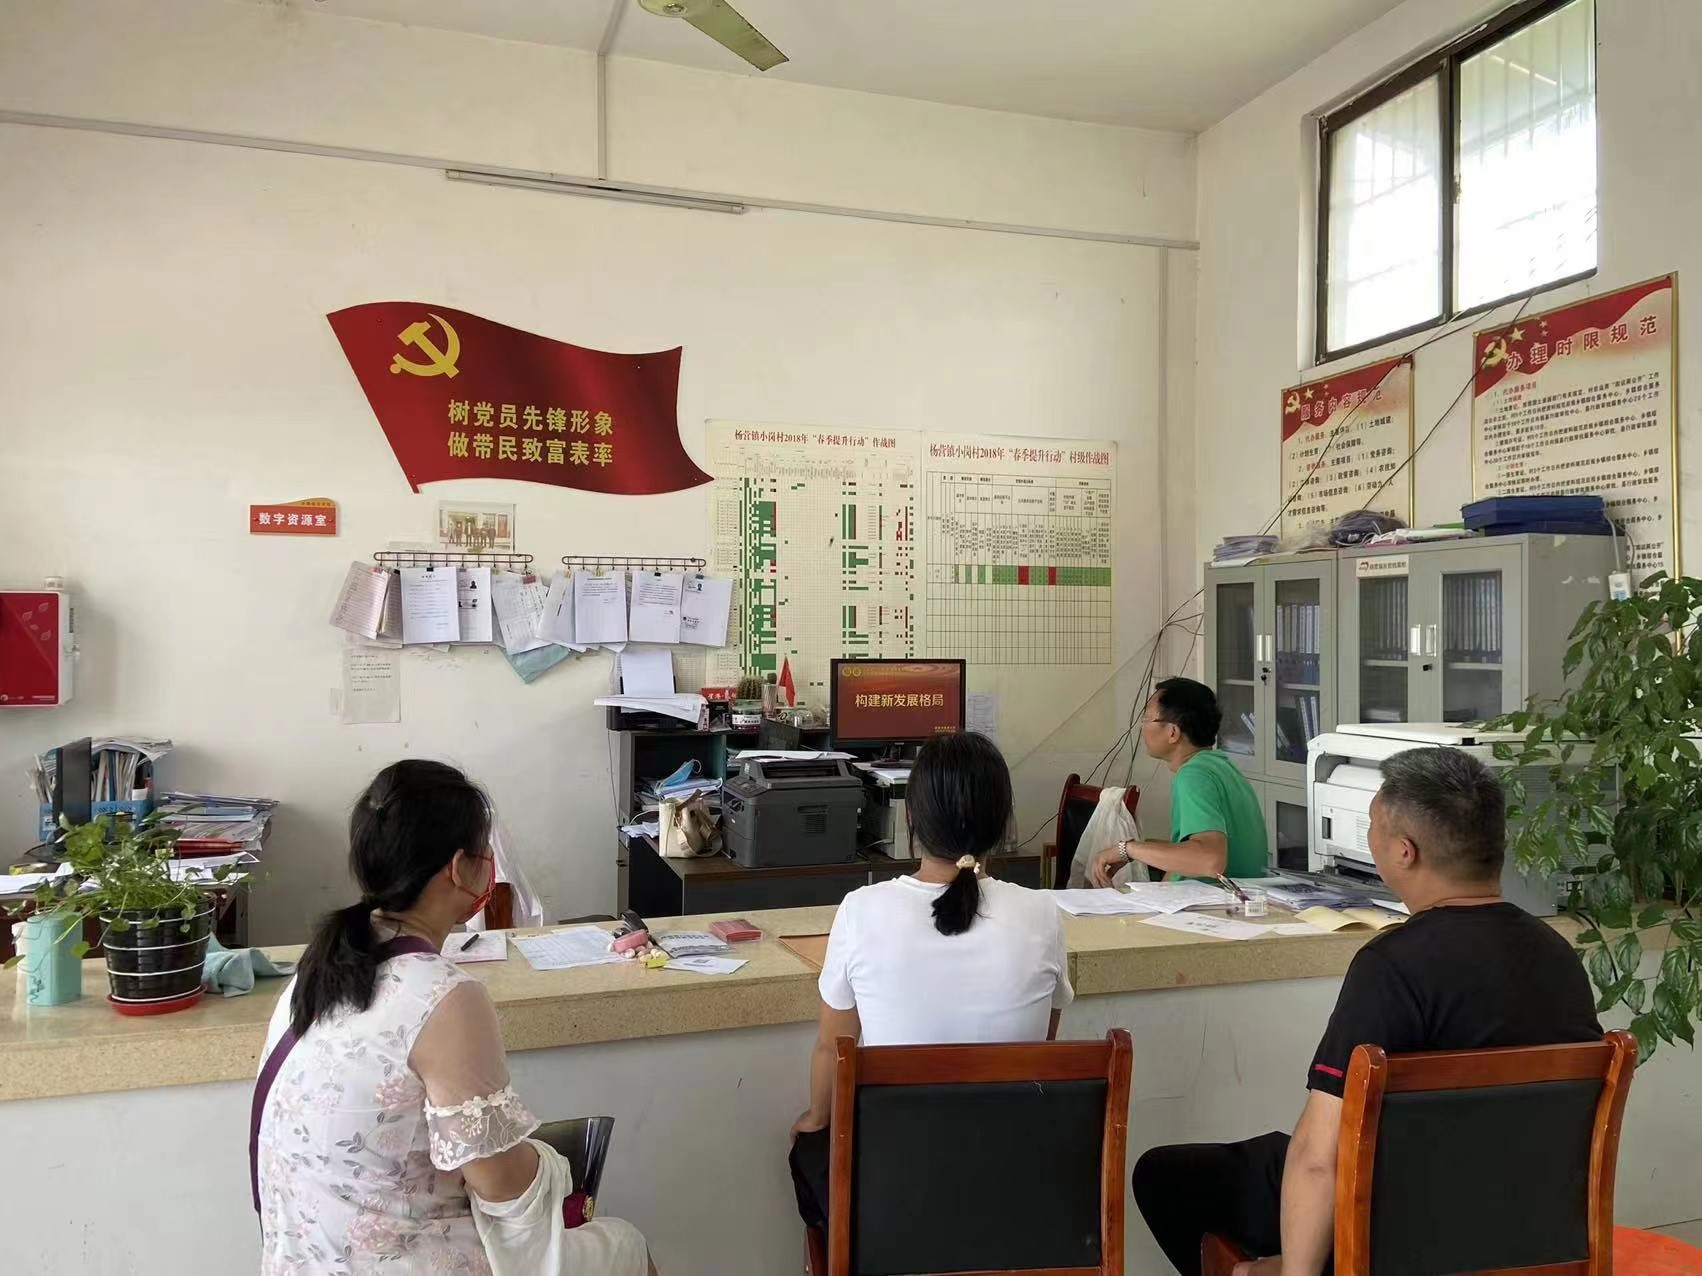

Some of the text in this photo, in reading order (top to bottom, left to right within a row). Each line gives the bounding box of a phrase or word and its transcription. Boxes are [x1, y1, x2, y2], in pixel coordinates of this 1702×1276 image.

[1506, 315, 1658, 371] 办理时限规范
[448, 399, 613, 436] 树党员先锋形象
[447, 431, 613, 467] 做带民致富表率
[258, 512, 327, 527] 数字资源室
[855, 694, 944, 707] 构建新发展格局
